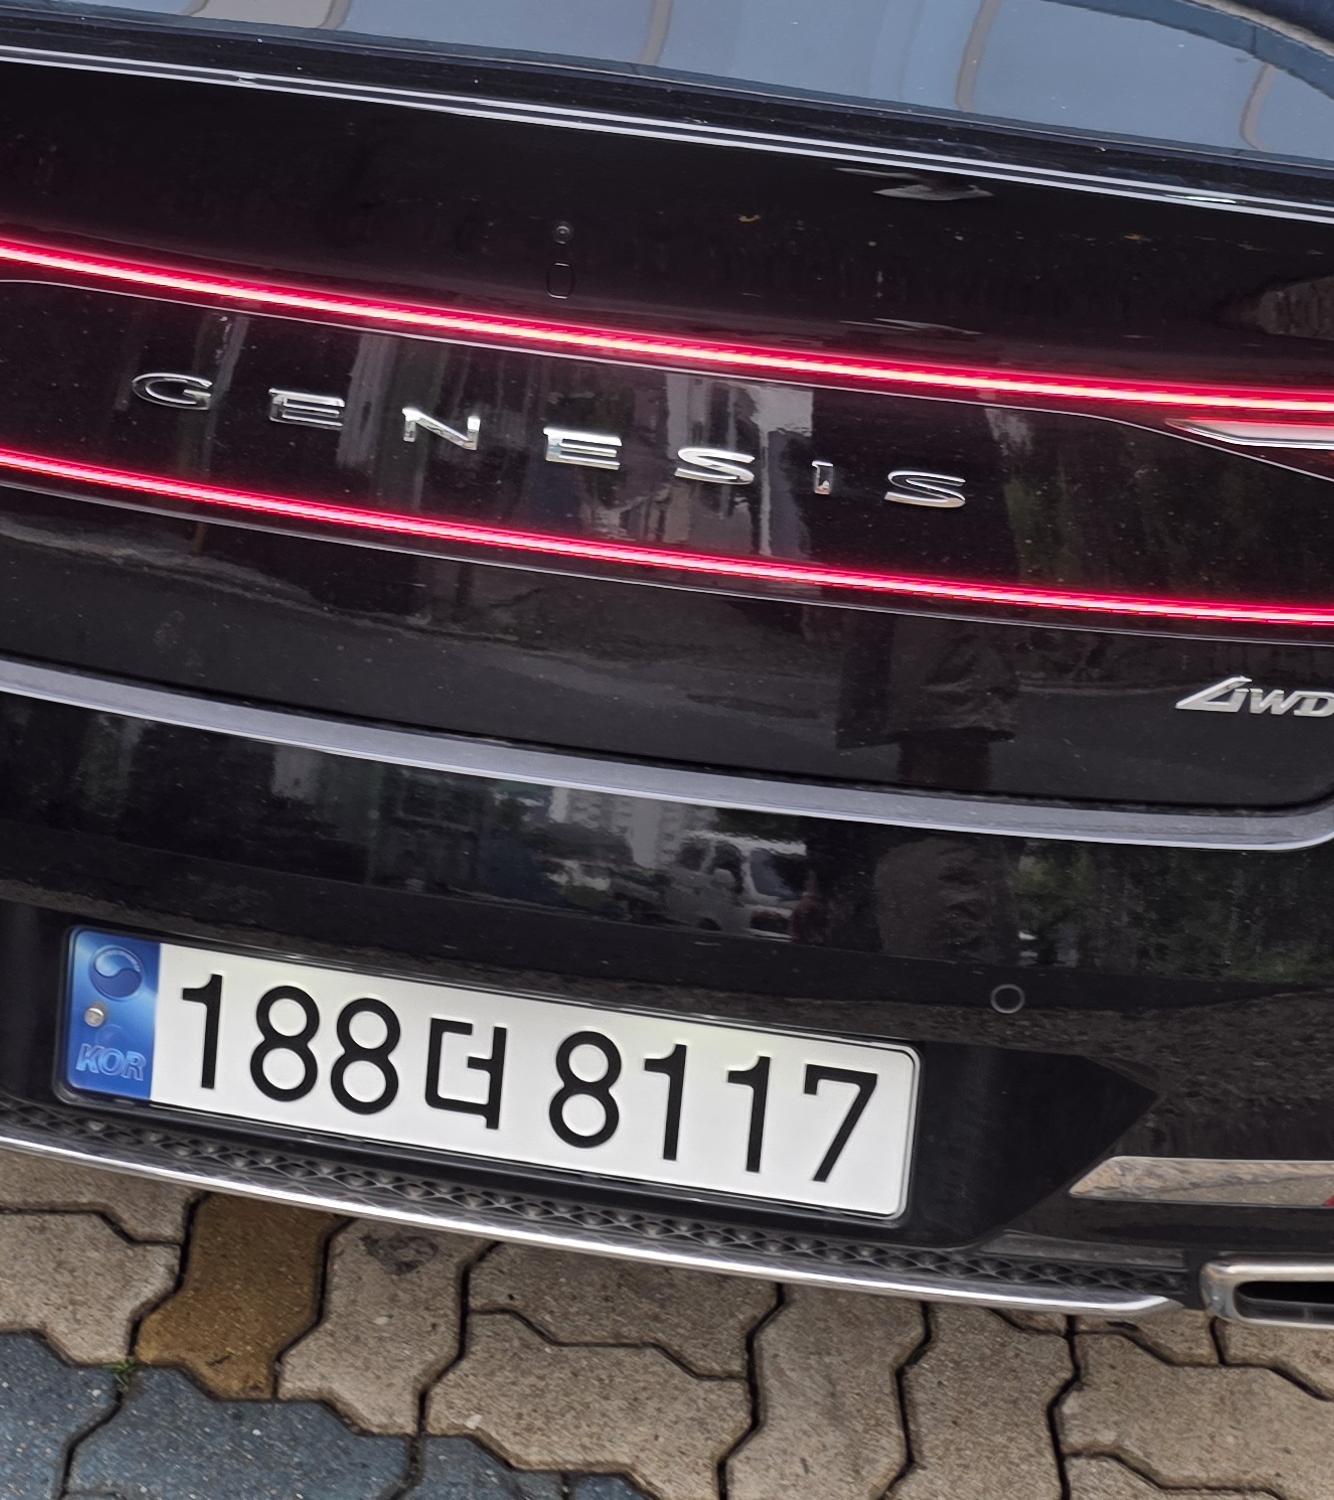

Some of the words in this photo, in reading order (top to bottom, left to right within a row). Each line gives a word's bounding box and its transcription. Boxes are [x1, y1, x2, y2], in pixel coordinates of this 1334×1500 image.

[132, 371, 967, 510] GENESIS
[75, 1042, 147, 1082] KOR
[181, 973, 509, 1131] 188더
[548, 1030, 879, 1185] 8117
